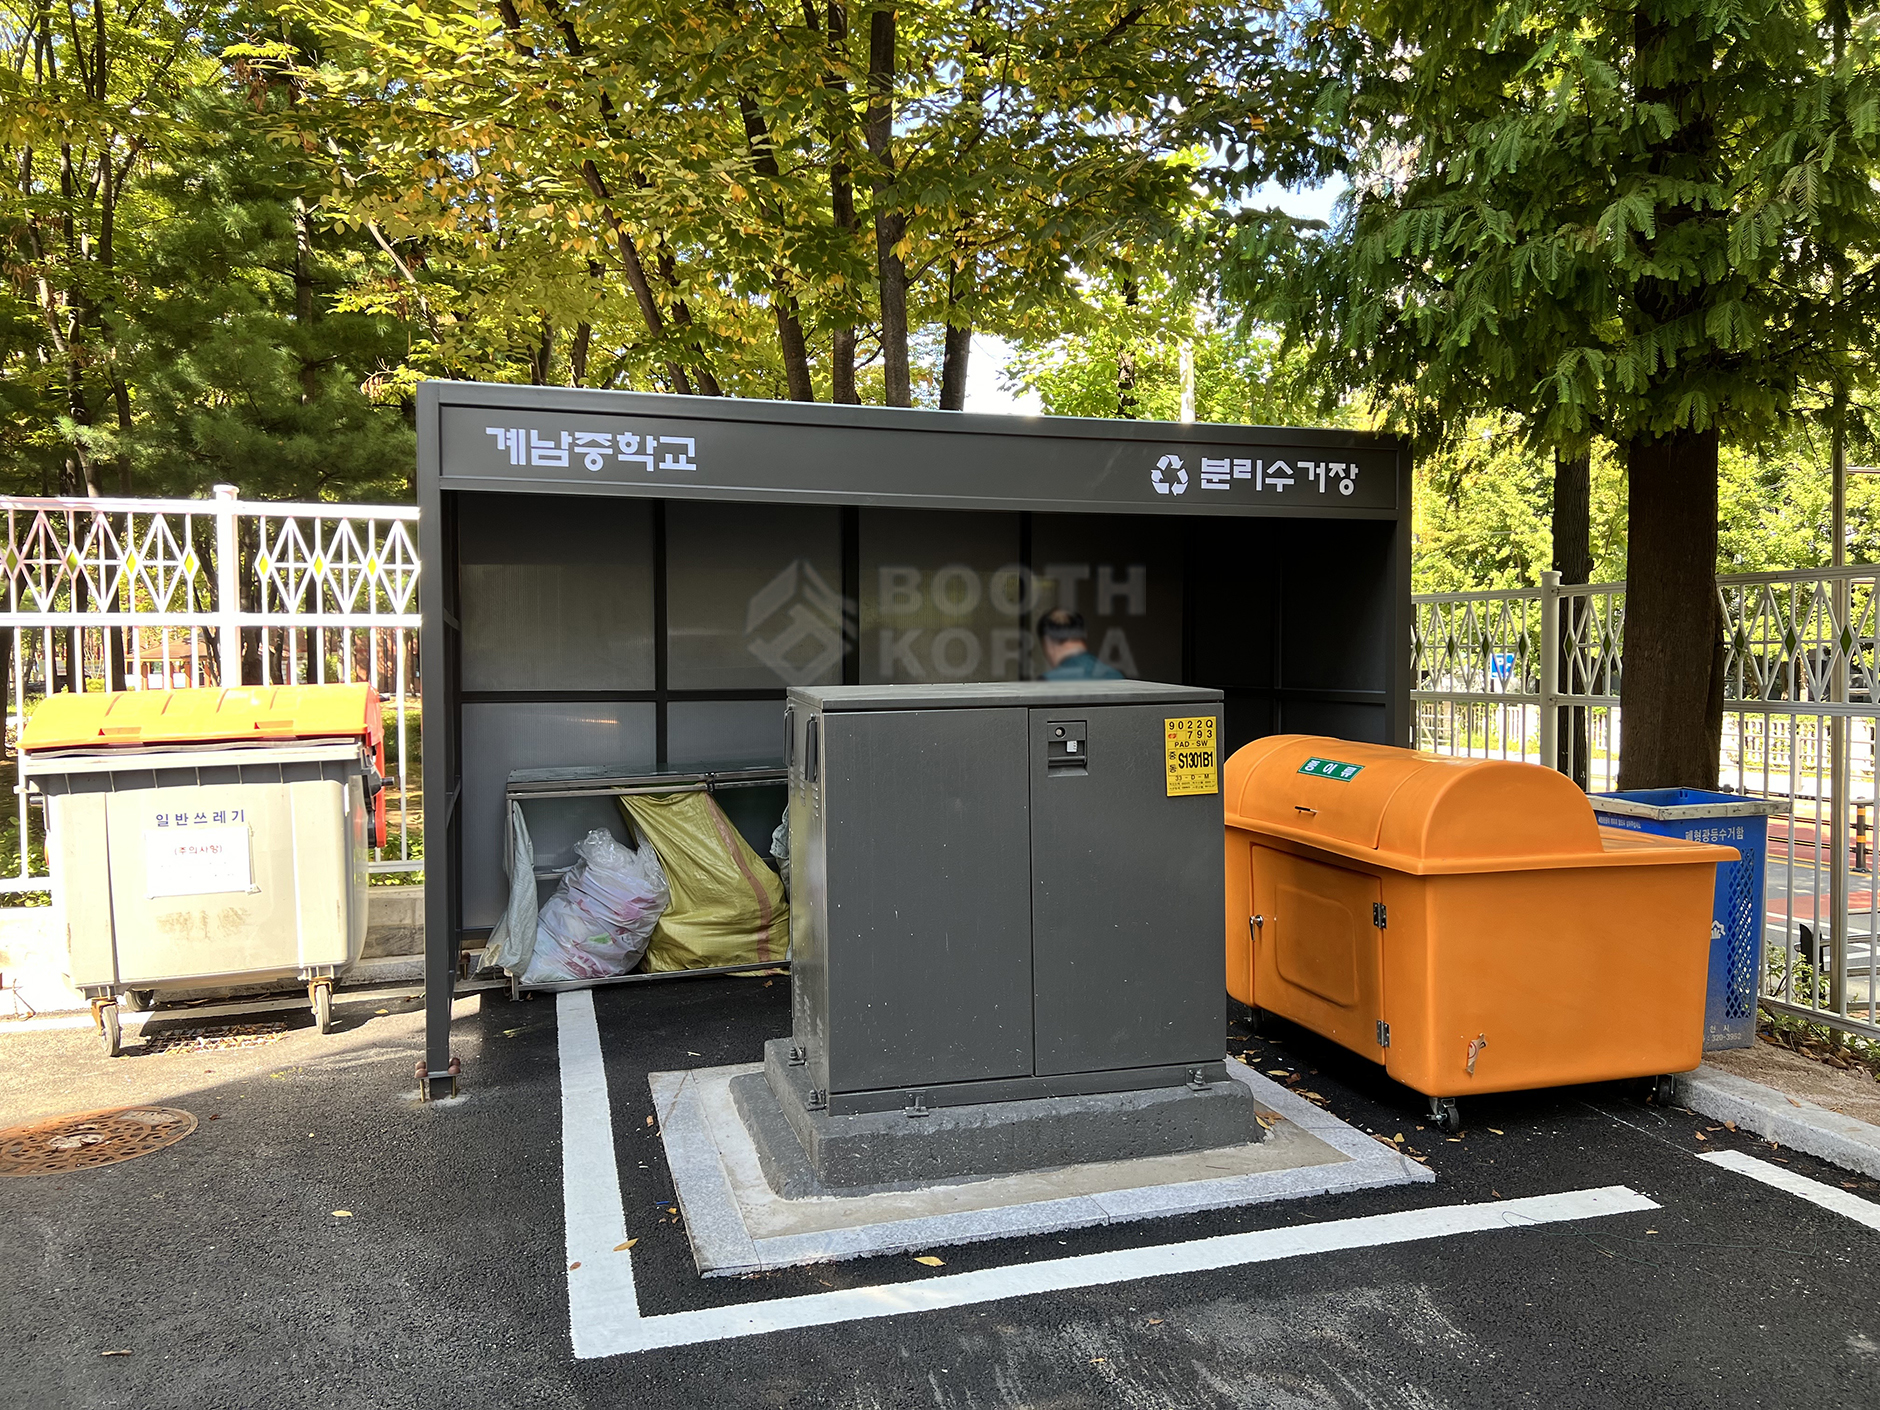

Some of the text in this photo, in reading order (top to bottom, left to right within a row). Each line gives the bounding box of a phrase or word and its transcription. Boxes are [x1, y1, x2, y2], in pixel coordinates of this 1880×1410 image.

[486, 427, 697, 472] 계남중학교
[1201, 457, 1359, 496] 분리수거장
[1187, 730, 1212, 739] 793
[1178, 751, 1213, 769] S1301B1
[156, 809, 244, 827] 일반쓰레기
